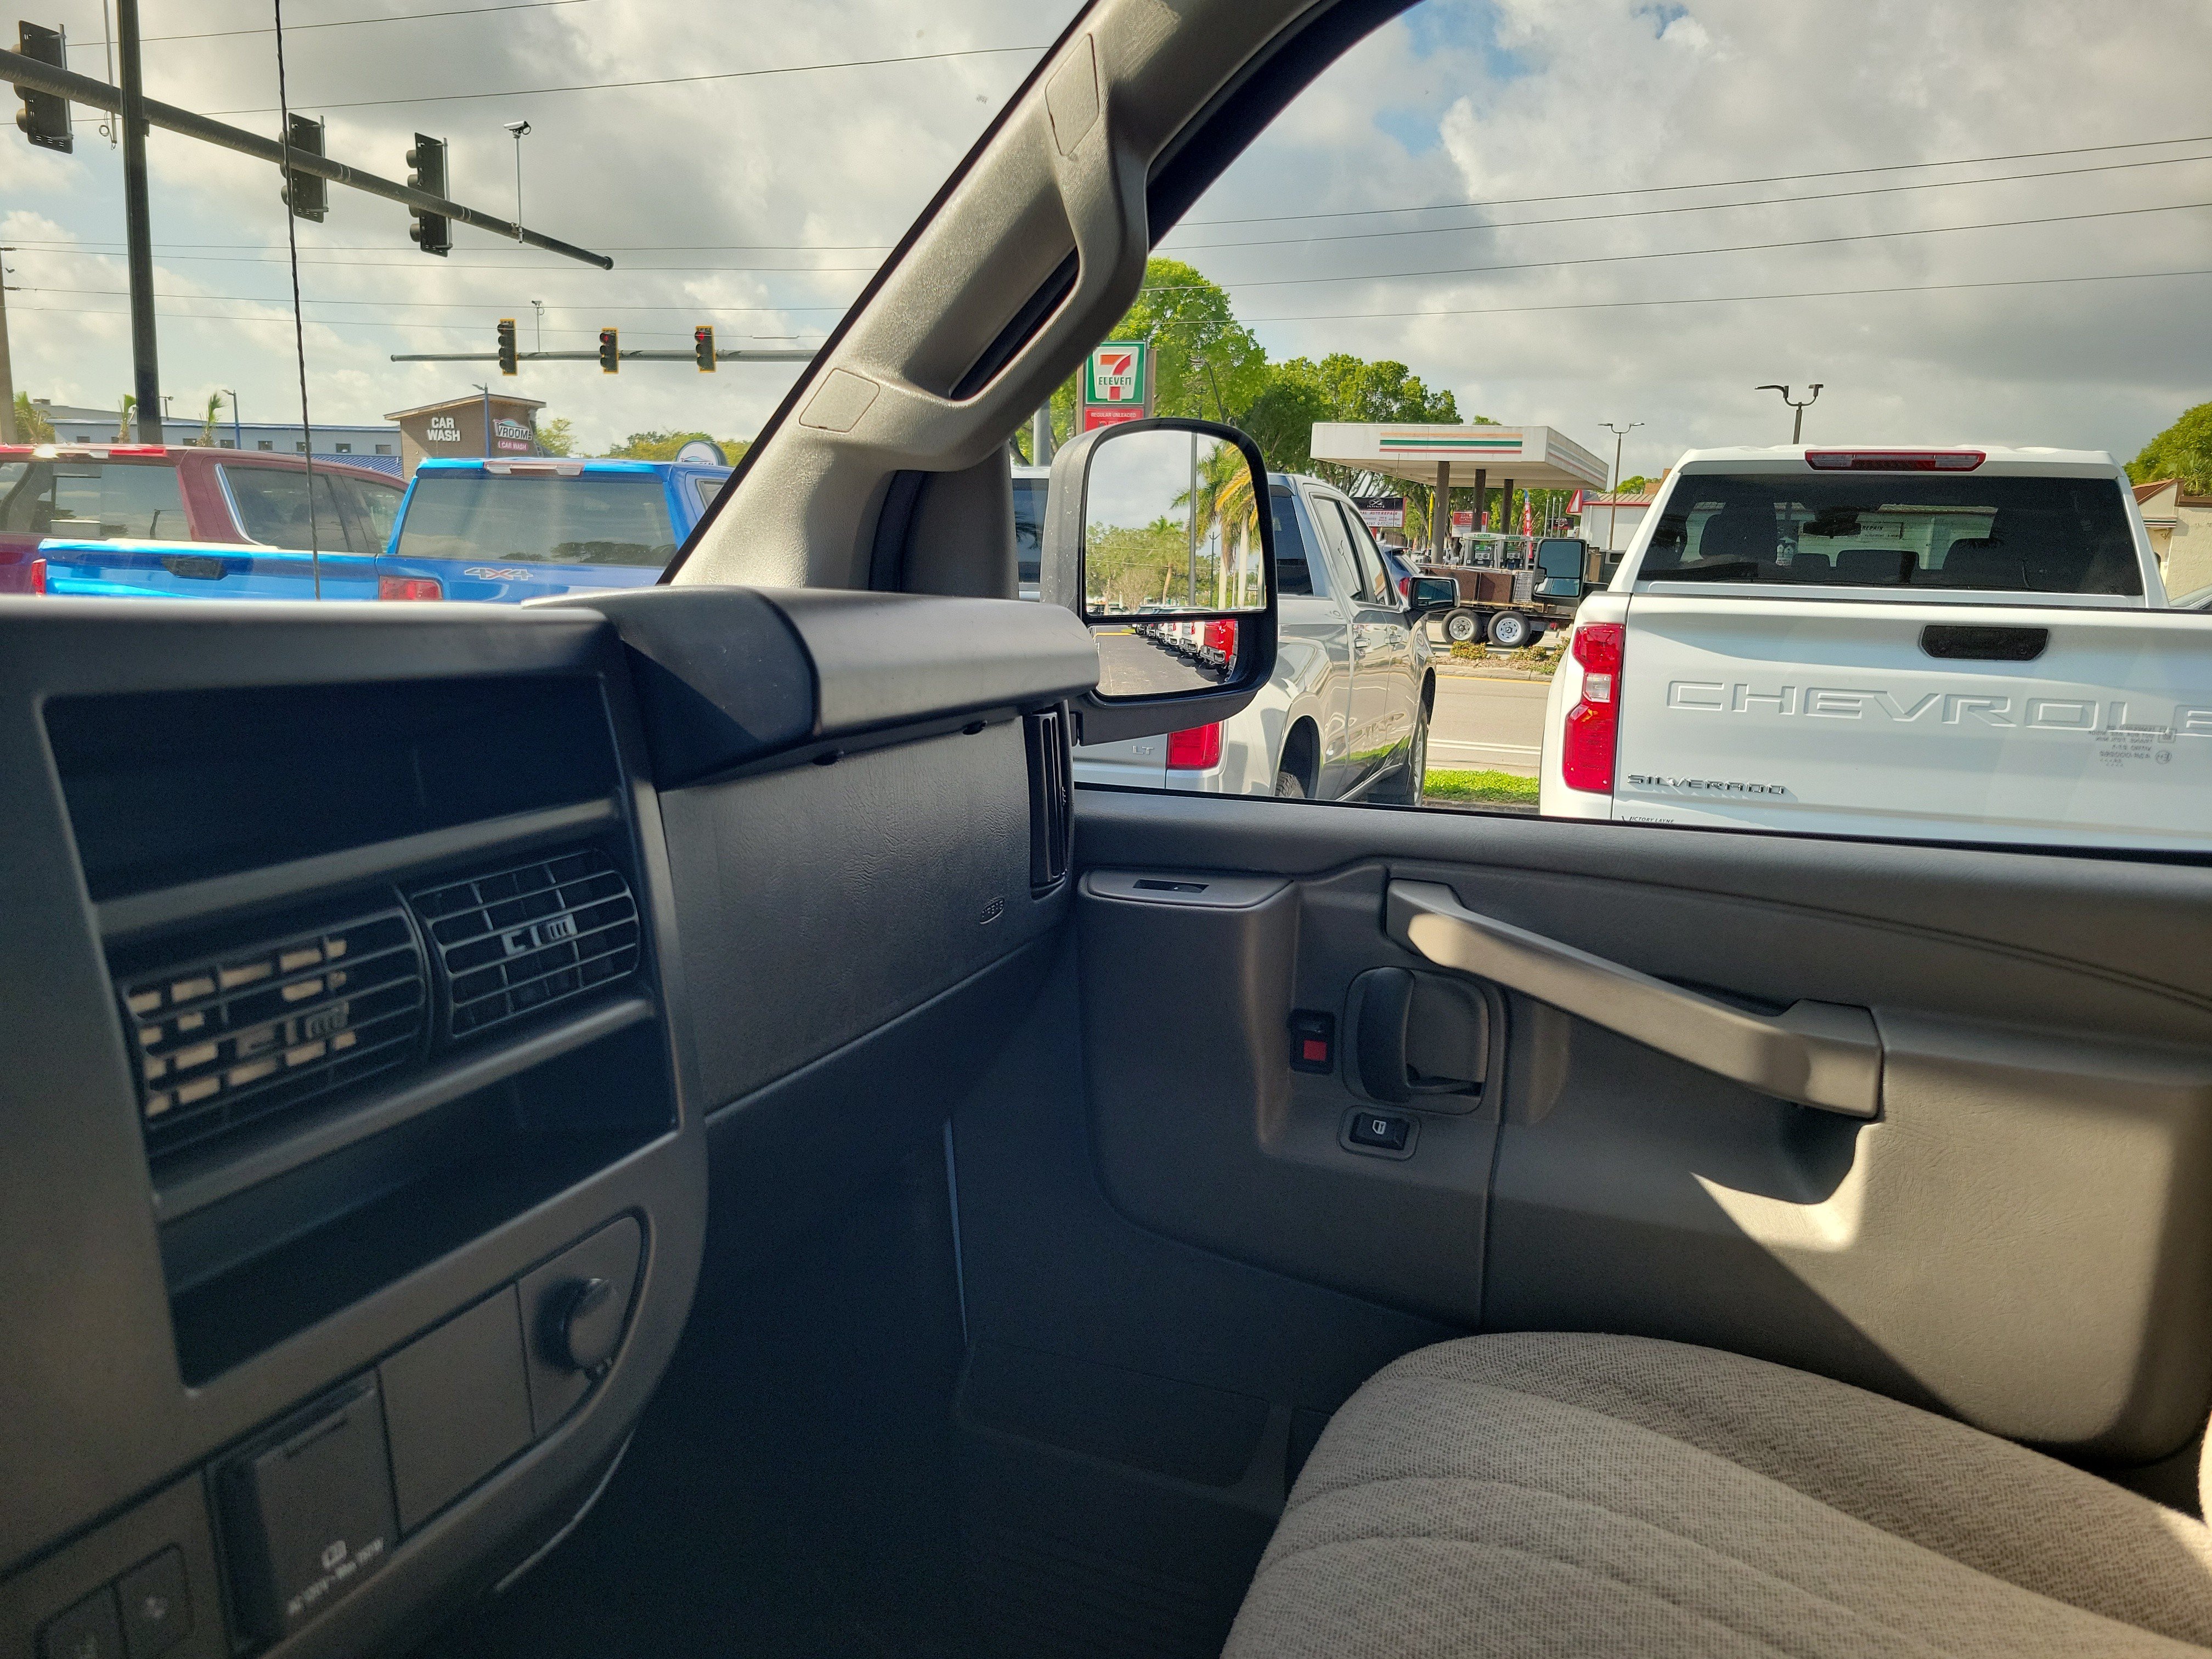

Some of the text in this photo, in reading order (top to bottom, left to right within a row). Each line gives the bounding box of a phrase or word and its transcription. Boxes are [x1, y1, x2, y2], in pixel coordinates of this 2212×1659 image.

[432, 417, 455, 429] CAR
[427, 430, 461, 442] WASH
[498, 426, 529, 439] VROOM
[1132, 745, 1154, 755] LT
[1627, 773, 1785, 795] SILVERADO
